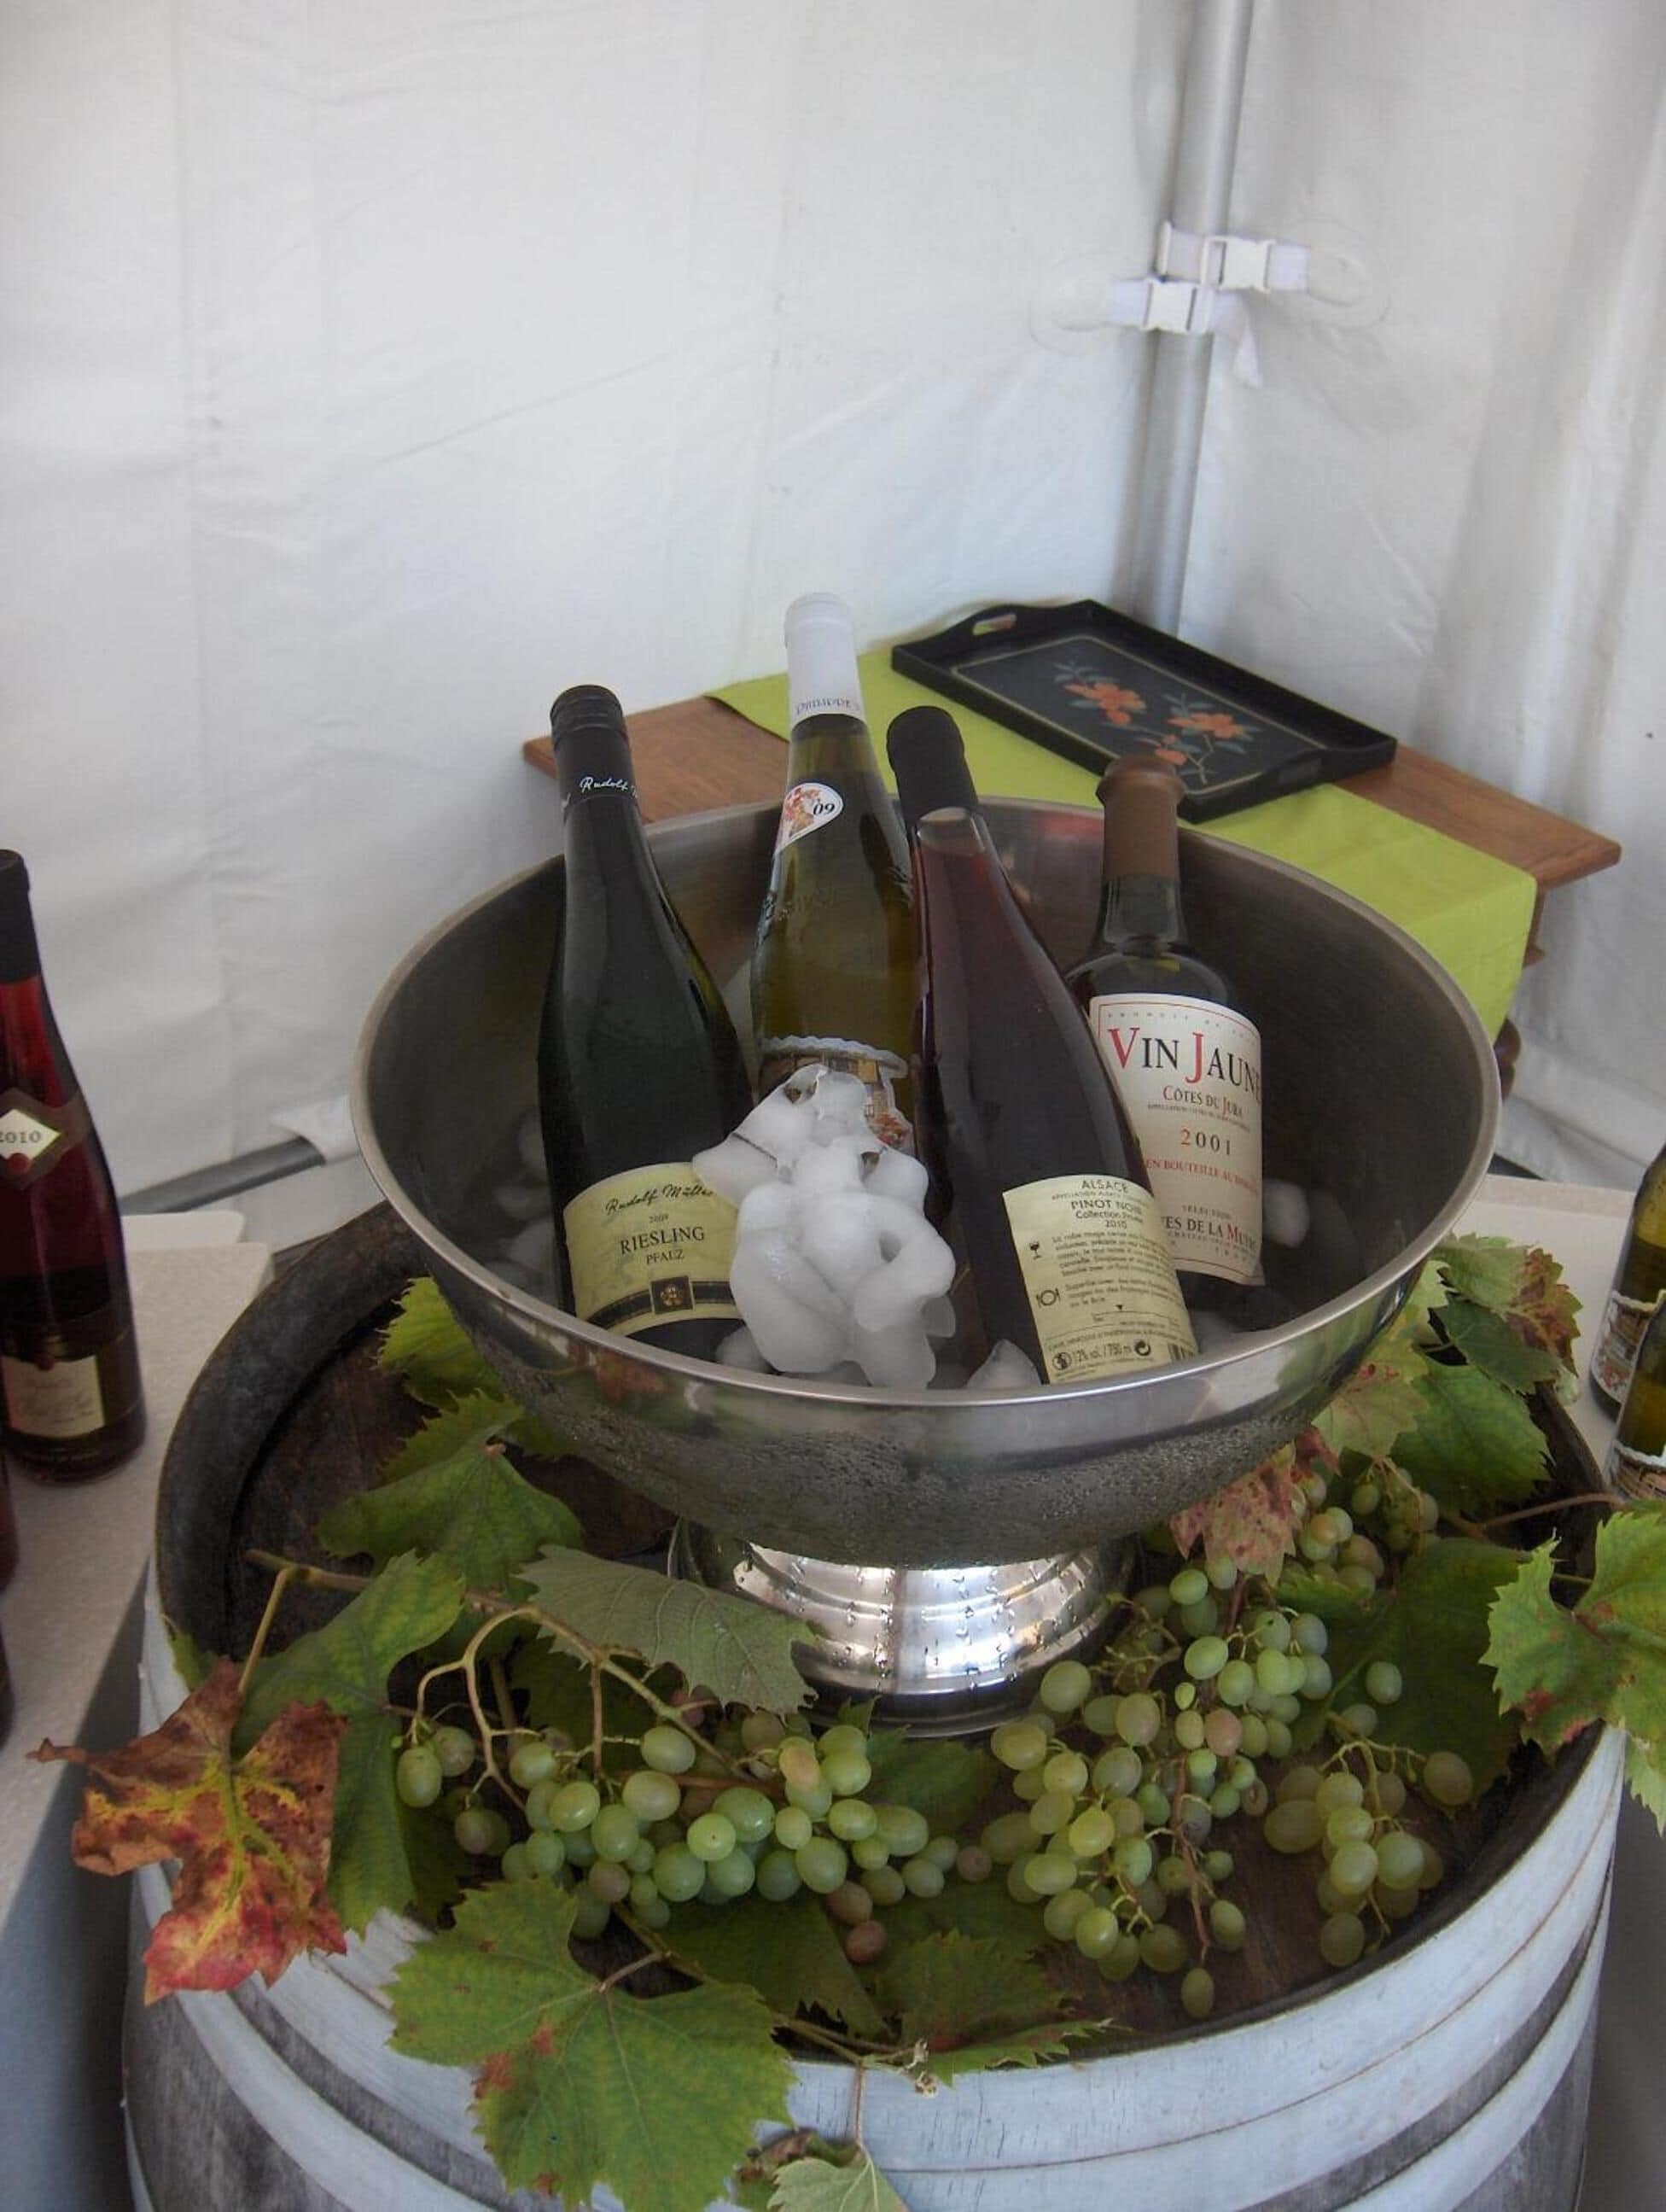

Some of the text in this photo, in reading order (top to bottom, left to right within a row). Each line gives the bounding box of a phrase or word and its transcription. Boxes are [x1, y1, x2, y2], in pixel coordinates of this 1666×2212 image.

[580, 776, 629, 793] Rudolf
[1108, 1027, 1180, 1070] VIN
[1180, 1129, 1231, 1155] 2001
[1081, 1179, 1129, 1194] ALSACE
[1071, 1199, 1111, 1210] PINOT
[1187, 1218, 1204, 1234] DE
[620, 1226, 705, 1255] RIESLING
[646, 1249, 684, 1266] PFALZ
